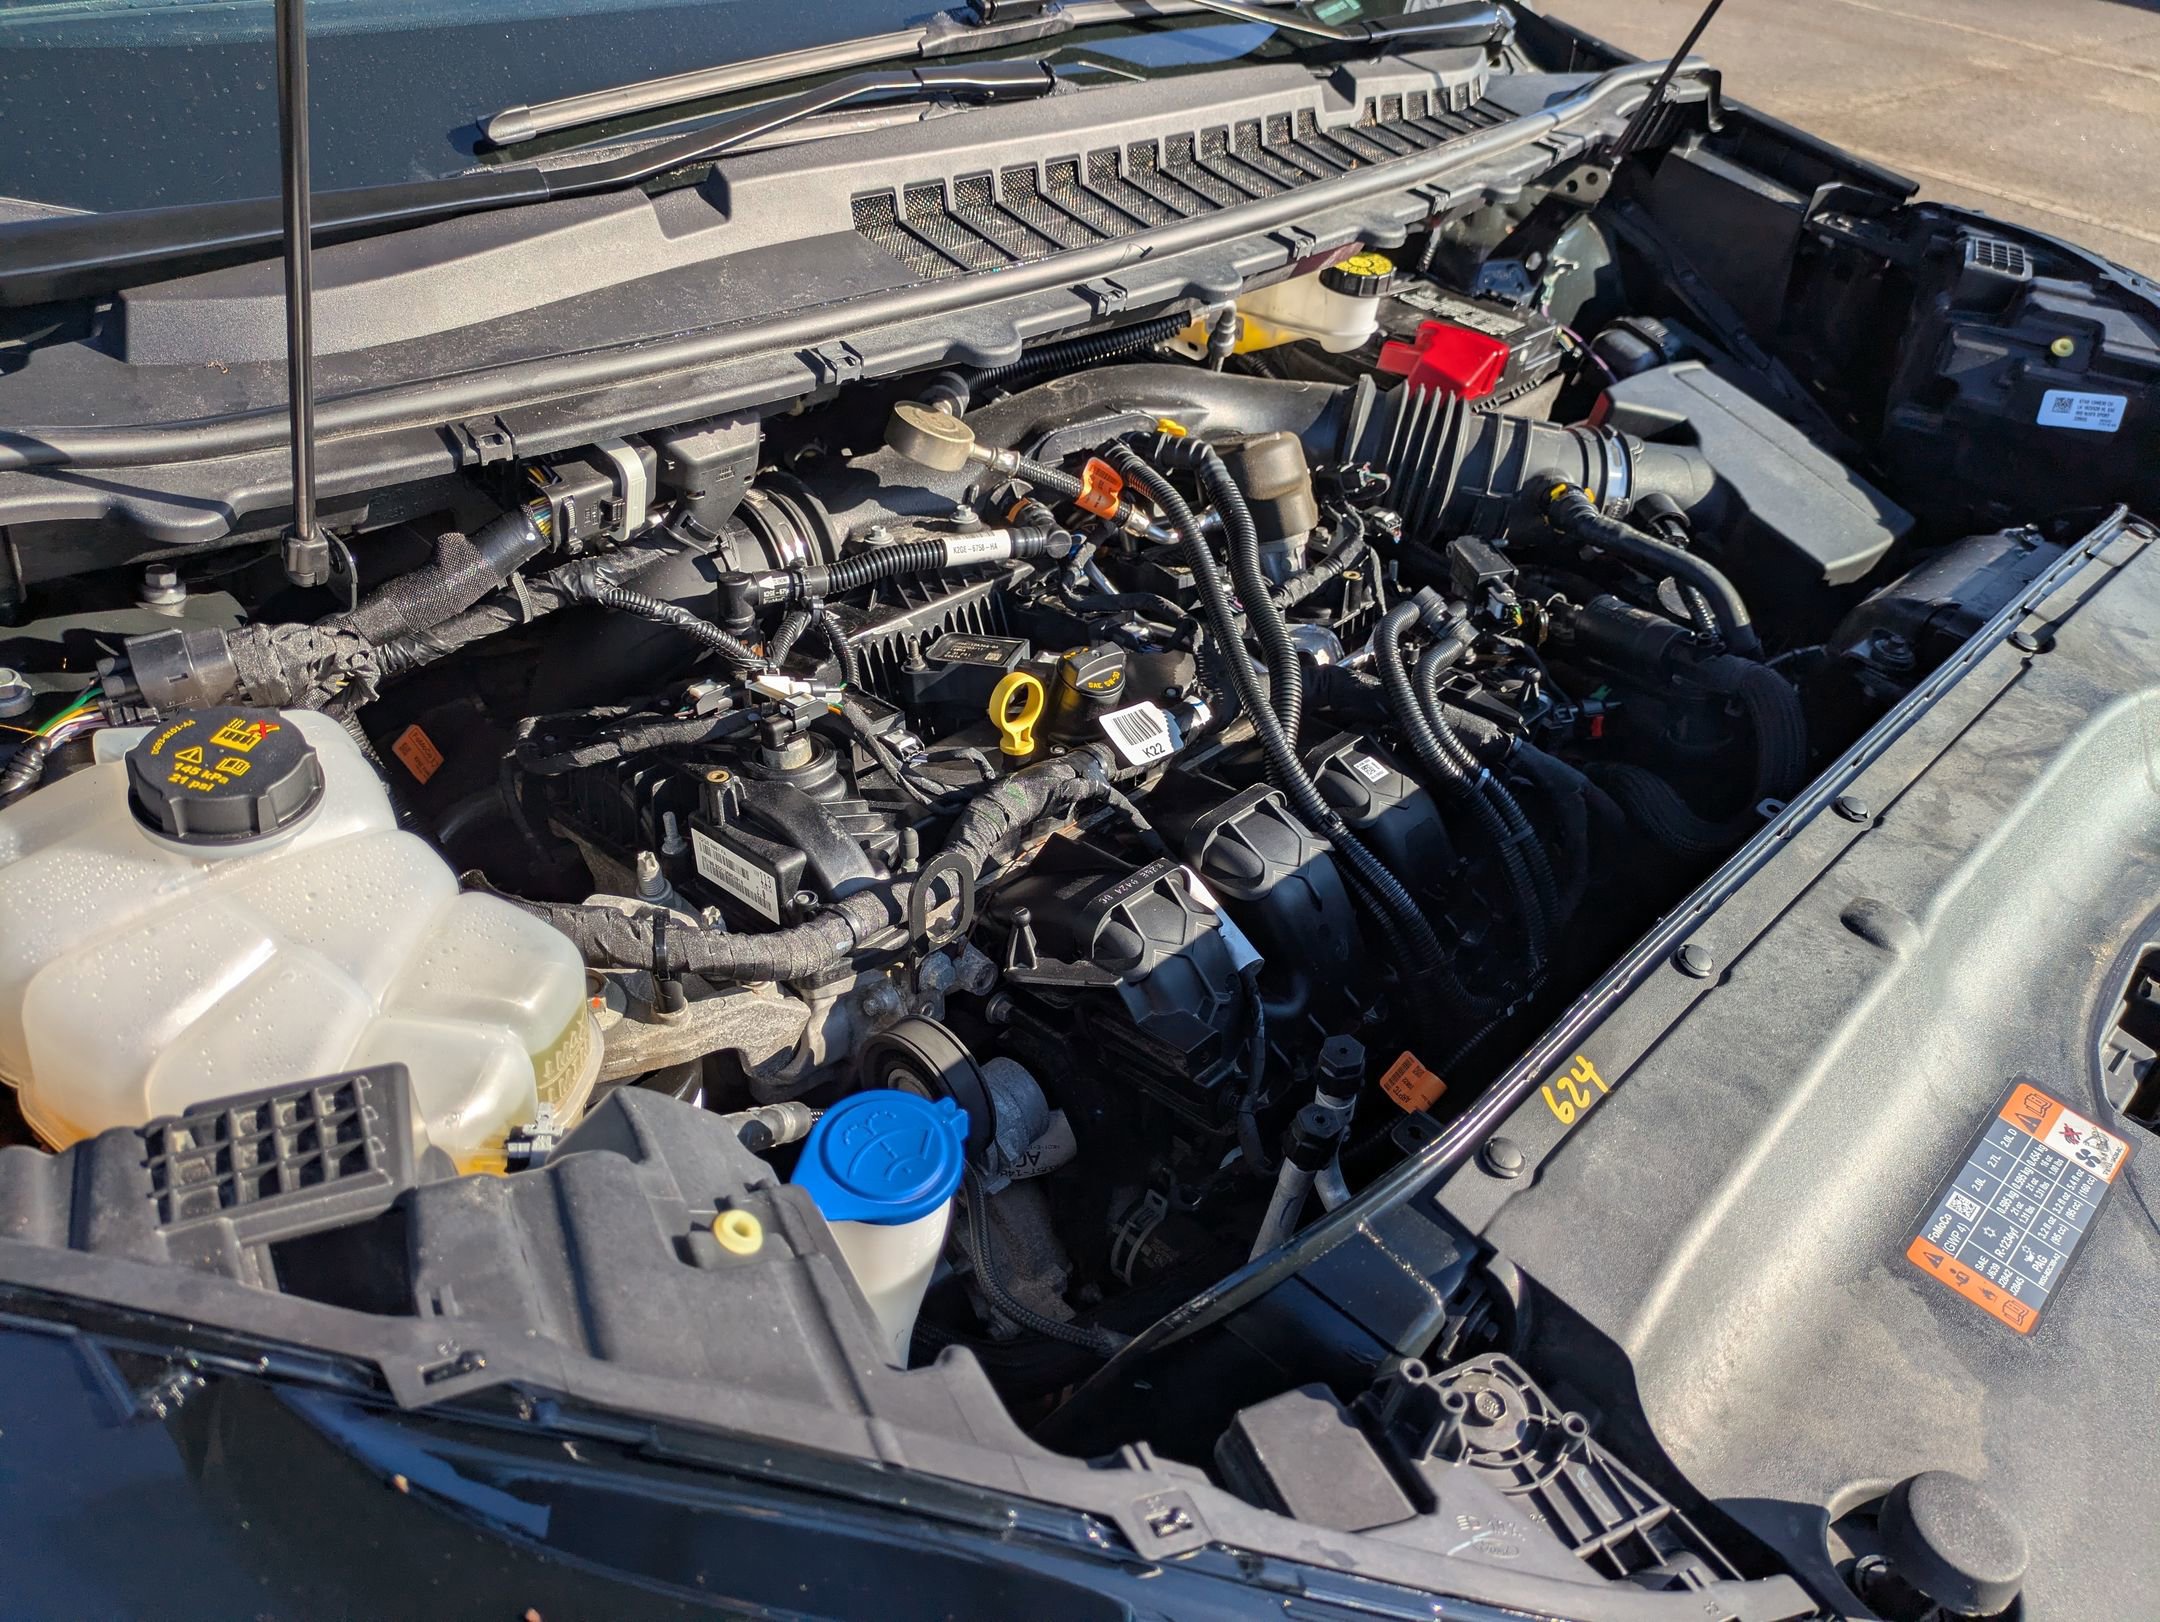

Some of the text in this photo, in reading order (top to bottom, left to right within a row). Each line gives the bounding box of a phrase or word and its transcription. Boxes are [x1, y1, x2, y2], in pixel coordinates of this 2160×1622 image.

[1142, 742, 1165, 758] K22
[168, 773, 215, 792] 21 psi
[174, 762, 229, 784] 145 kPa
[1541, 1055, 1609, 1125] 624
[1987, 1152, 2000, 1168] 2.7L
[2027, 1142, 2047, 1167] 0.454 kg
[2054, 1157, 2063, 1167] lbs
[1972, 1176, 1985, 1192] 2.0L
[2012, 1165, 2033, 1190] 0.595 kg
[2026, 1182, 2034, 1191] 21
[2067, 1178, 2078, 1190] 5.4
[2076, 1168, 2084, 1177] oz
[2078, 1174, 2097, 1198] (160 cc)
[2034, 1180, 2049, 1200] 1.31 lbs
[1996, 1189, 2018, 1214] 0.595 kg
[2011, 1200, 2023, 1215] 21 oz
[2053, 1201, 2065, 1214] 3.2
[2062, 1191, 2071, 1200] oz
[2065, 1199, 2083, 1221] (95 cc)
[2018, 1203, 2035, 1224] 1.31 lbs
[1928, 1212, 1952, 1243] FoMoCo
[2038, 1226, 2049, 1239] 3.2
[2047, 1215, 2056, 1224] oz
[2050, 1223, 2068, 1245] (95 cc)
[1944, 1222, 1970, 1256] (GWP 4)
[1995, 1226, 2020, 1258] R-1234yf
[1975, 1255, 1988, 1271] SAE
[1986, 1262, 2001, 1279] J639
[2031, 1254, 2047, 1272] PAG
[1997, 1268, 2013, 1288] J2842
[2009, 1276, 2025, 1295] J2845
